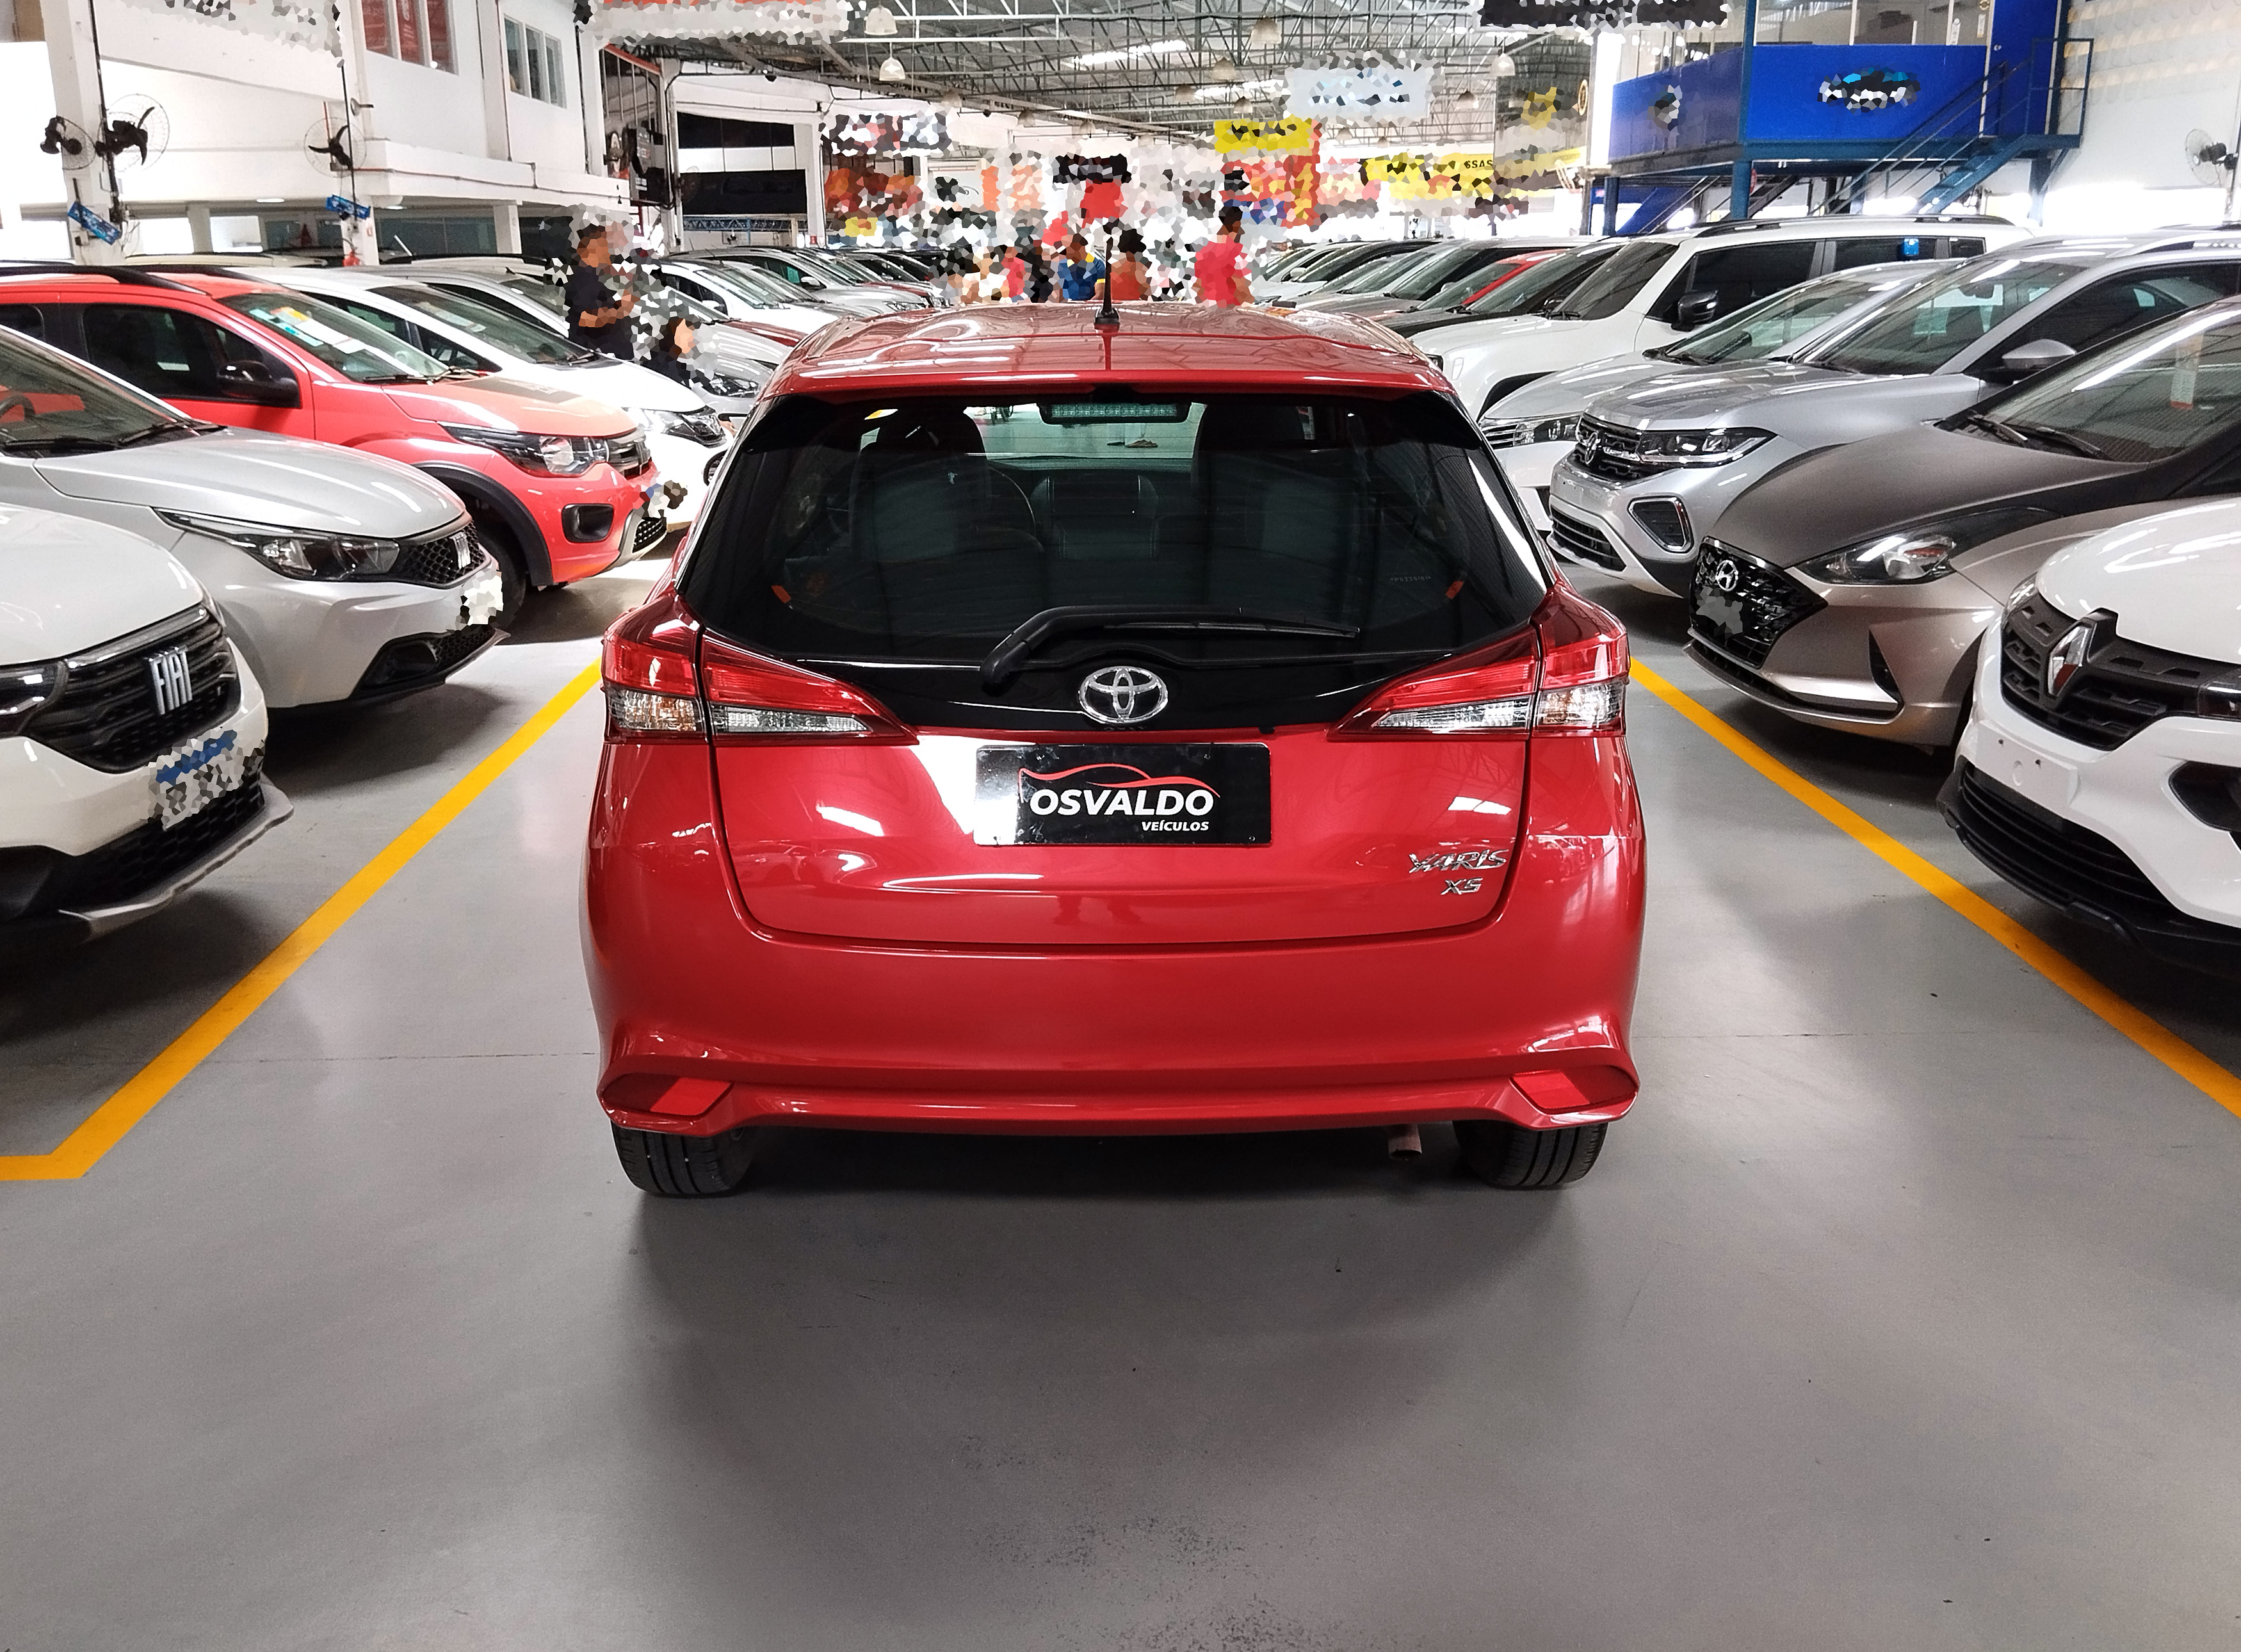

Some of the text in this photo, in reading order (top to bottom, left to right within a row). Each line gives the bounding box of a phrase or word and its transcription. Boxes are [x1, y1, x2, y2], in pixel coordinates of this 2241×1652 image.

[149, 645, 193, 715] FIAT
[1030, 789, 1214, 816] OSVALDO
[1142, 820, 1209, 831] VEÍCULOS
[1409, 849, 1509, 873] YARIS
[1441, 877, 1484, 895] XS
